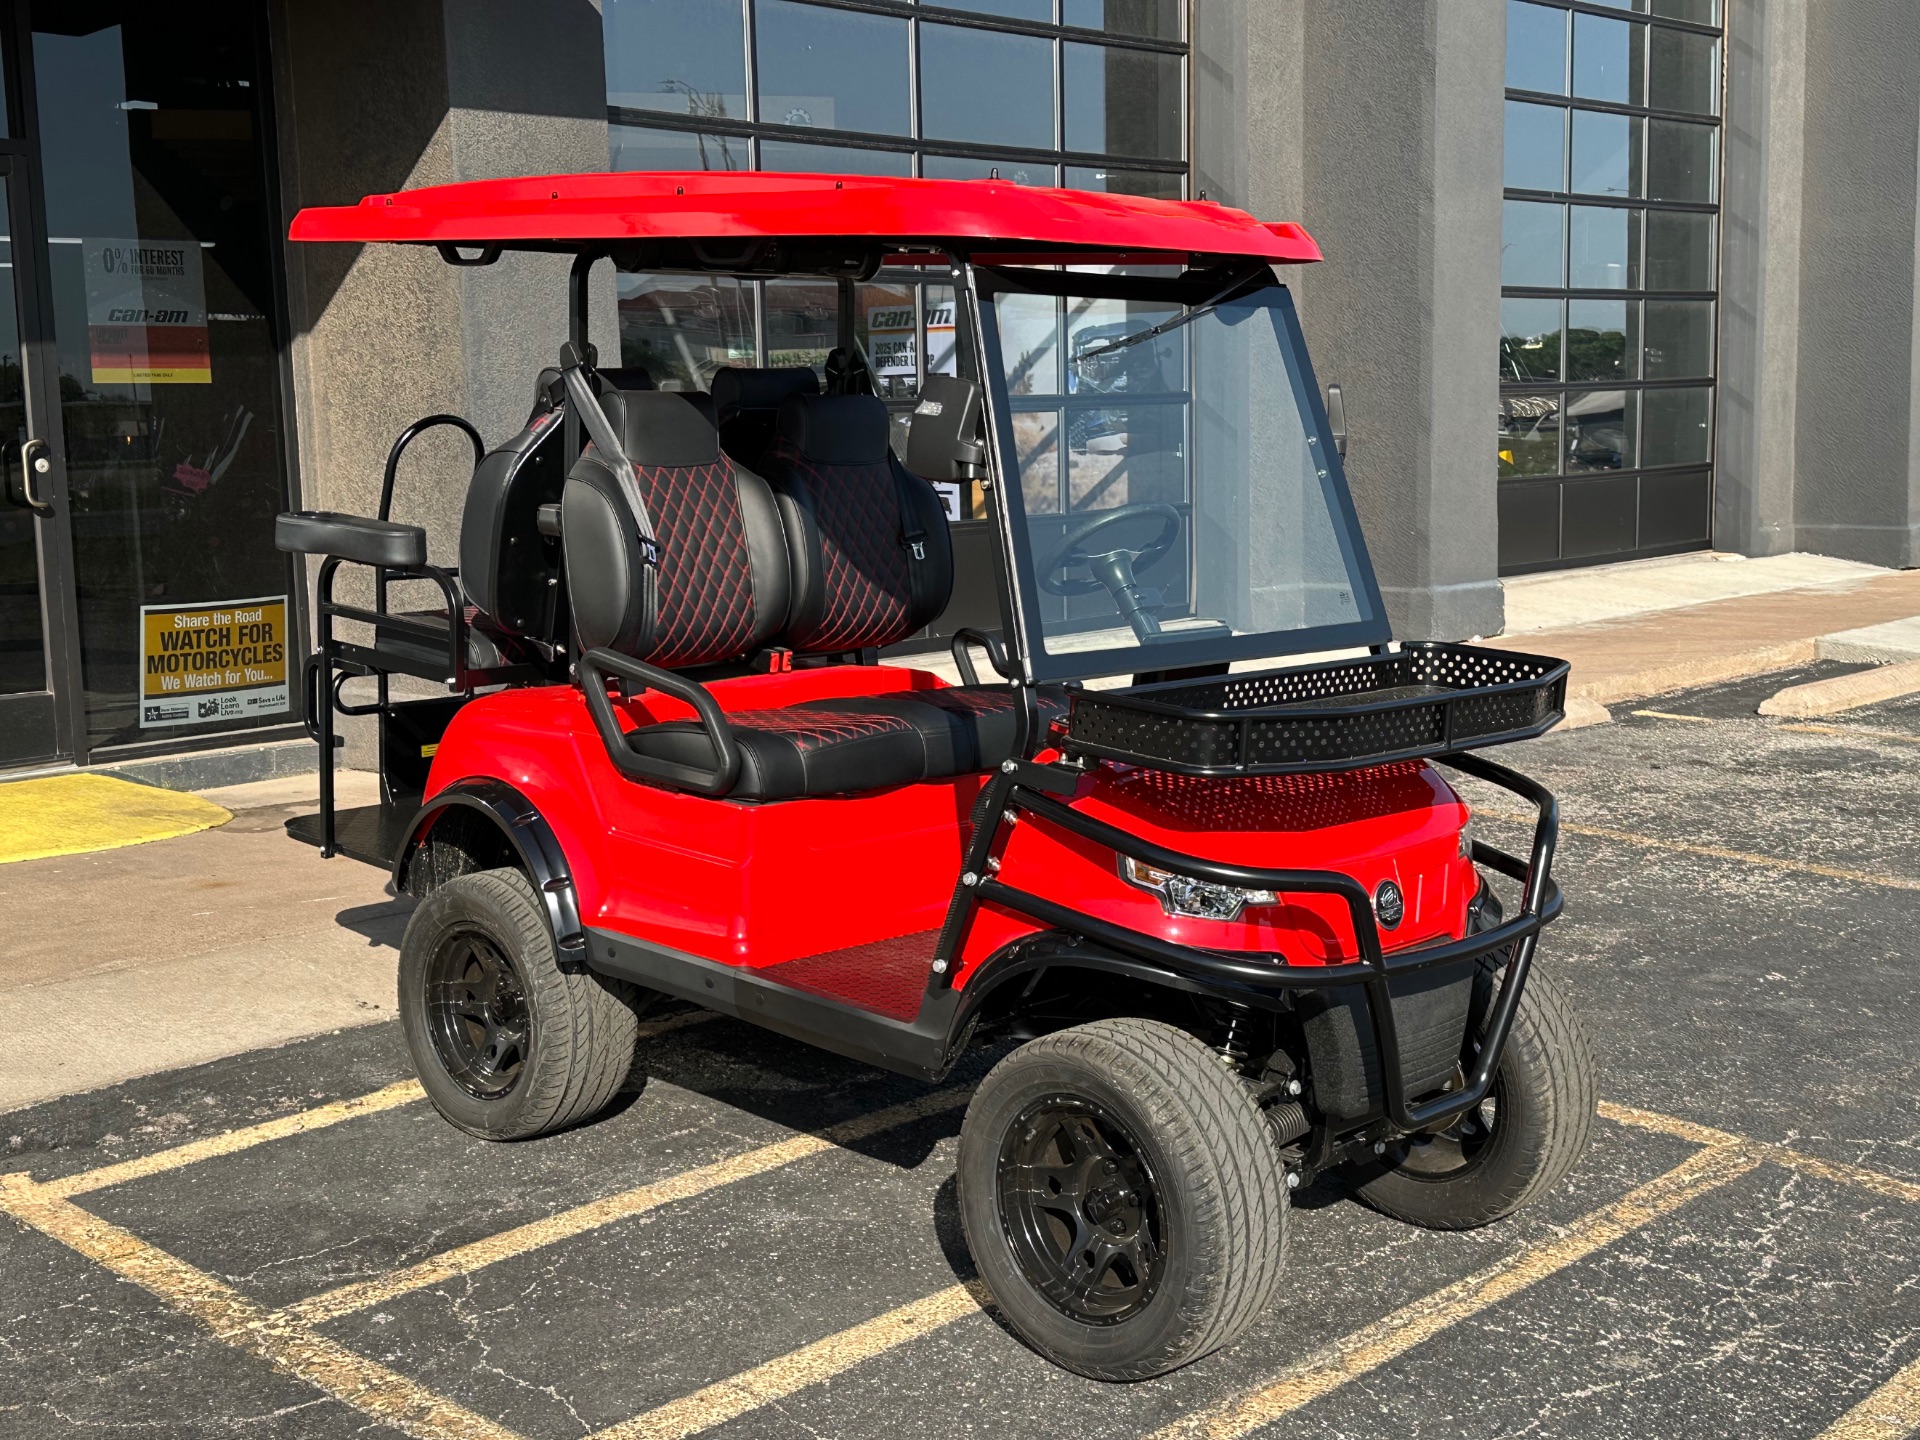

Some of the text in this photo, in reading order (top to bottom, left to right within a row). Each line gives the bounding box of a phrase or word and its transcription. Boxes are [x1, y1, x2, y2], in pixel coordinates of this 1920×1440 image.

[103, 247, 185, 274] 0% INTEREST
[131, 265, 185, 276] FOR 60 MONTHS
[108, 308, 189, 323] can-am
[872, 308, 952, 328] can-m
[875, 341, 915, 355] 2025 CAN-A
[875, 354, 909, 368] DEFENDER
[174, 609, 262, 629] Share the Road
[160, 622, 273, 652] WATCH FOR
[147, 643, 283, 675] MOTORCYCLES
[161, 675, 181, 691] We
[184, 672, 222, 689] Watch
[225, 669, 242, 685] for
